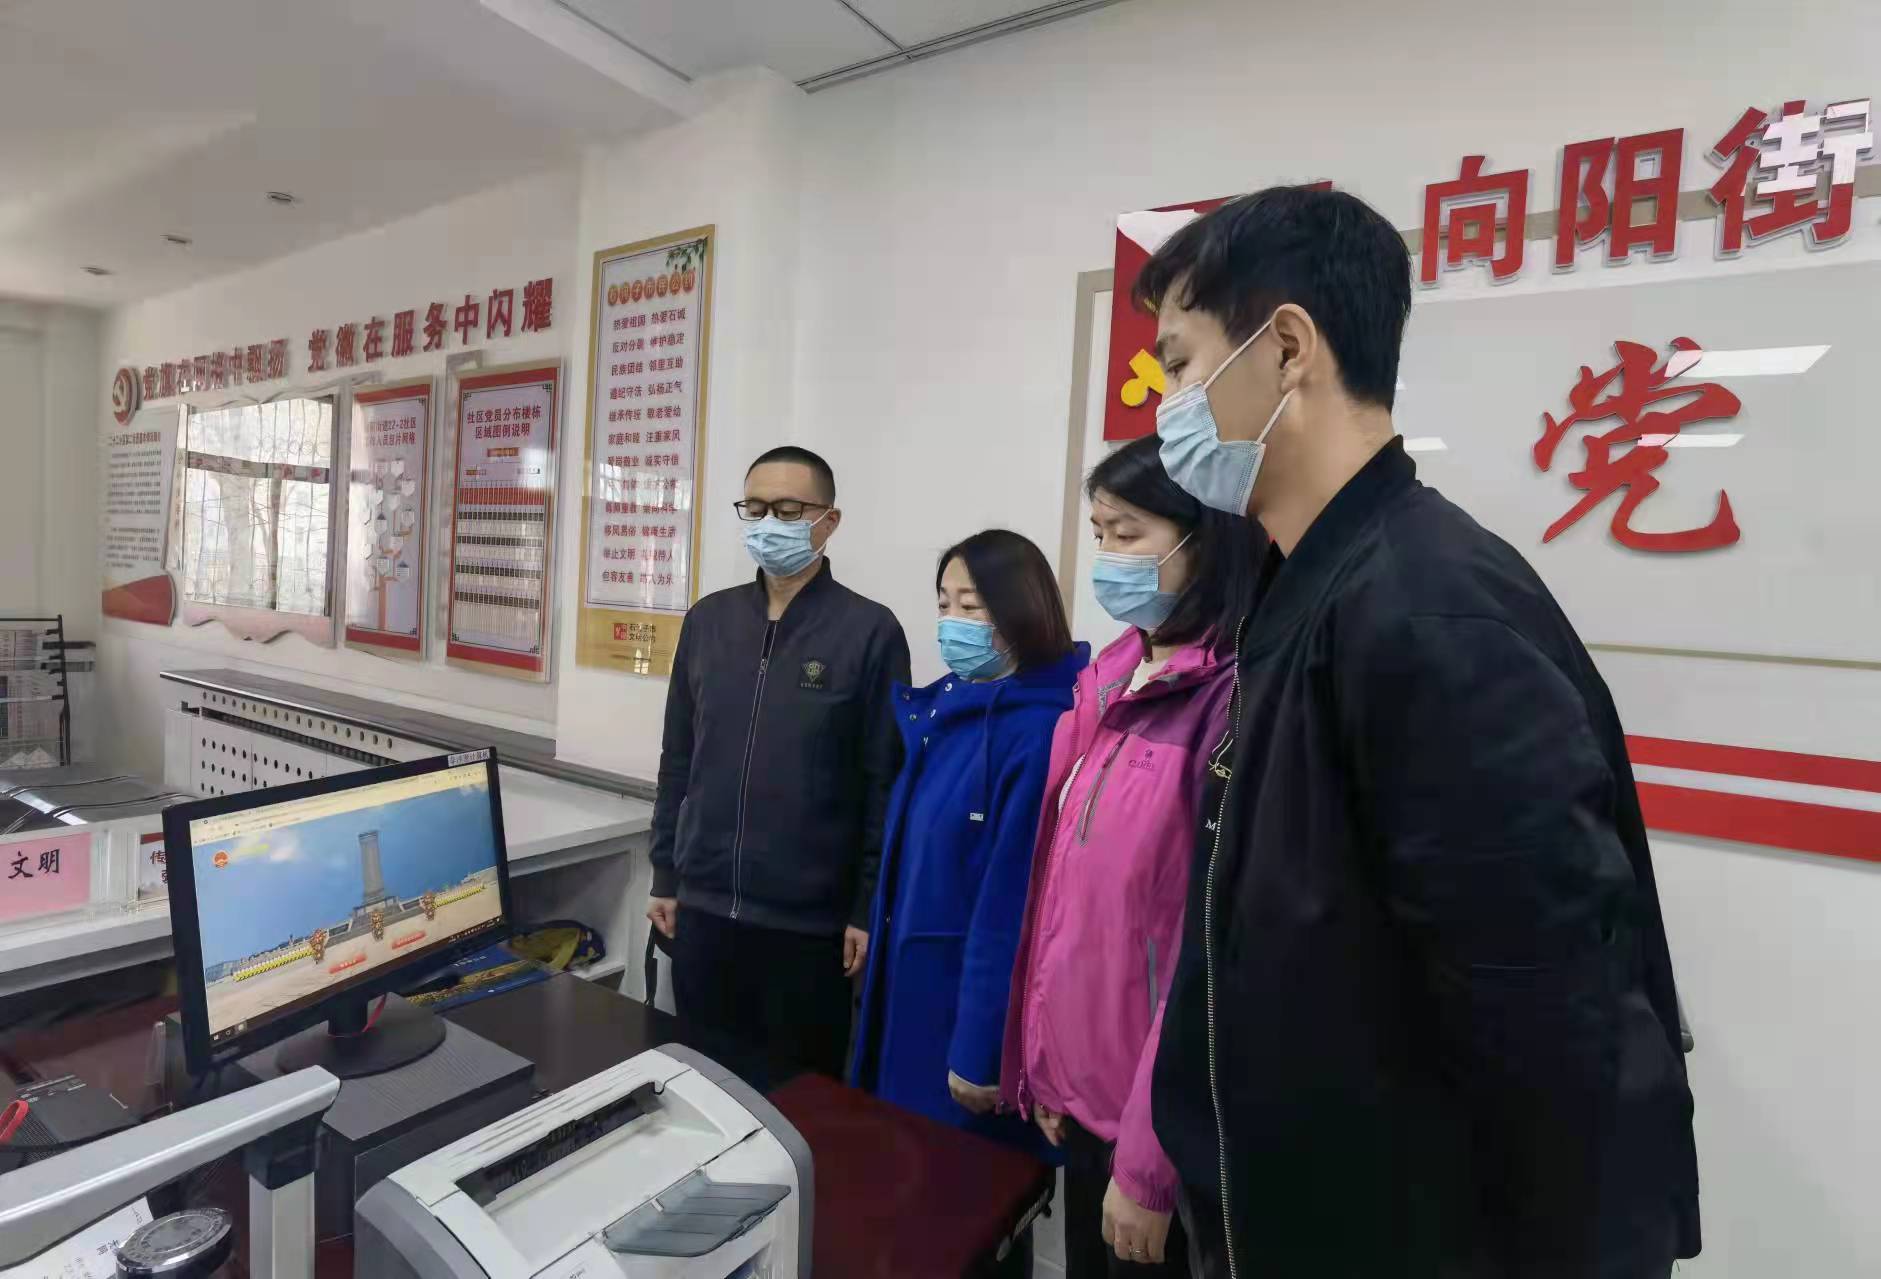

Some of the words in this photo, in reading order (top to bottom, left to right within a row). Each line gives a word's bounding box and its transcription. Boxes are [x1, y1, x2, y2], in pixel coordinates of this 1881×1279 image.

[1420, 98, 1871, 284] 向阳街
[307, 278, 553, 372] 党徽在服务中闪耀
[613, 314, 646, 331] 热爱祖国
[651, 308, 686, 325] 热爱石城
[611, 361, 643, 376] 民族团结
[649, 355, 683, 372] 邻里互助
[609, 386, 642, 400] 遵纪守法
[648, 380, 682, 396] 弘扬正气
[467, 404, 541, 424] 社区党员分布楼栋
[608, 408, 641, 422] 继承传统
[647, 404, 681, 419] 敬老爱幼
[475, 422, 530, 439] 区域图例说明
[608, 432, 640, 445] 家庭和睦
[646, 429, 680, 443] 注重家风
[1533, 336, 1742, 552] 党
[645, 454, 679, 467] 诚实守信
[604, 524, 636, 537] 移风易俗
[7, 848, 61, 880] 文明
